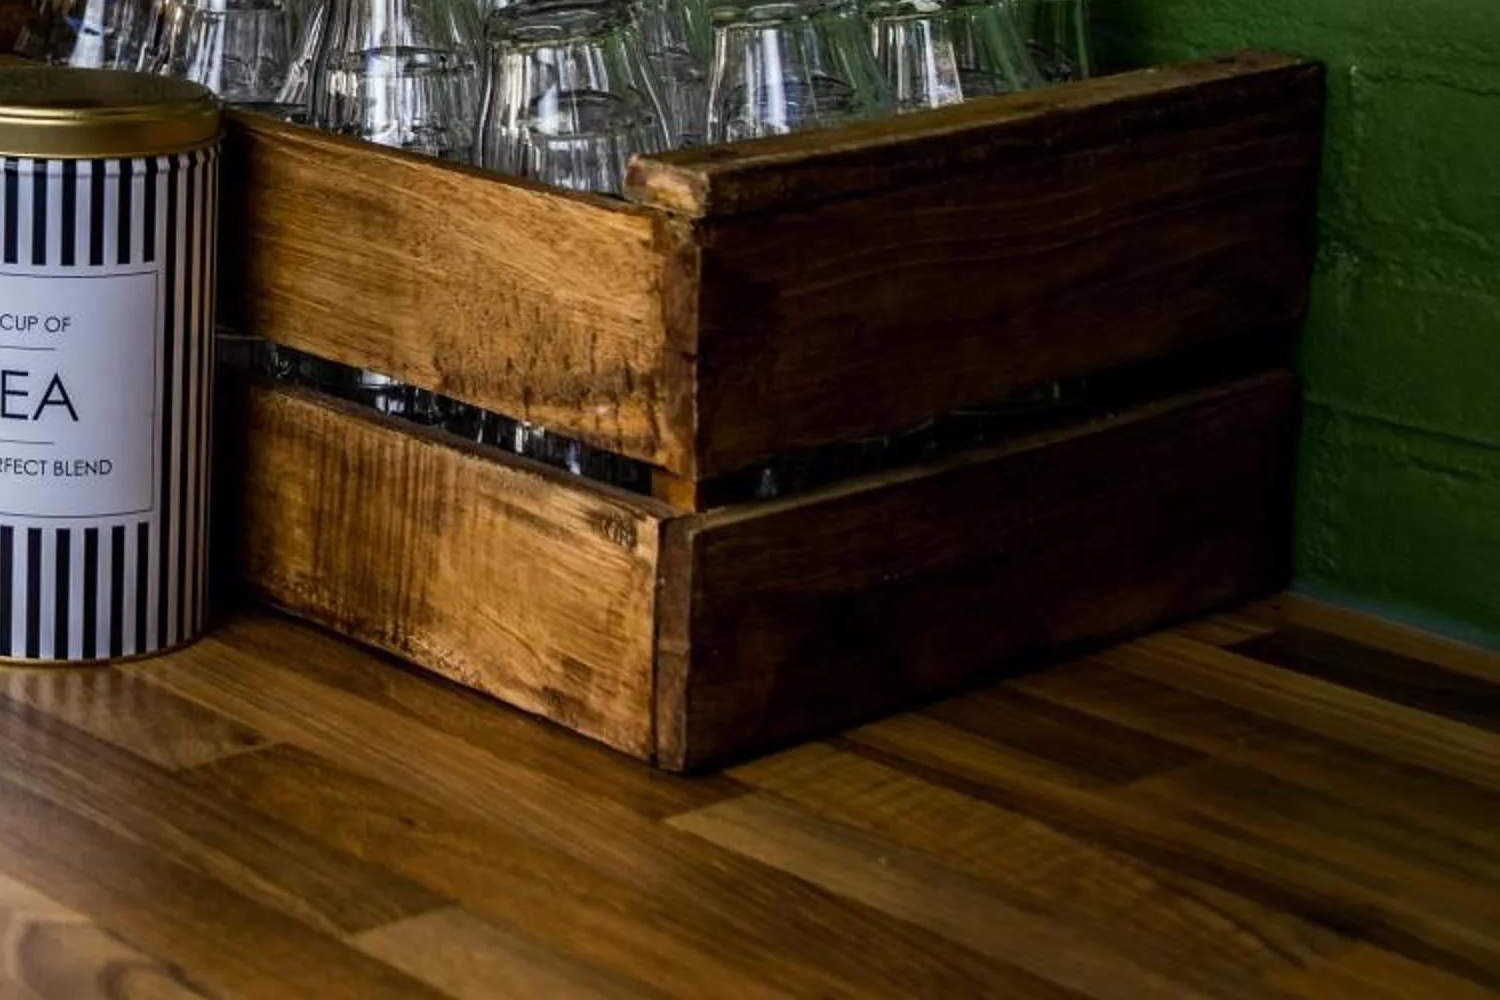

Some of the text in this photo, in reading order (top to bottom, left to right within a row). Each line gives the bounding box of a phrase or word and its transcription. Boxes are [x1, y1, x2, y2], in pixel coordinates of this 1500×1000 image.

[0, 313, 38, 331] CUP
[44, 316, 72, 333] OF
[53, 459, 113, 477] BLEND
